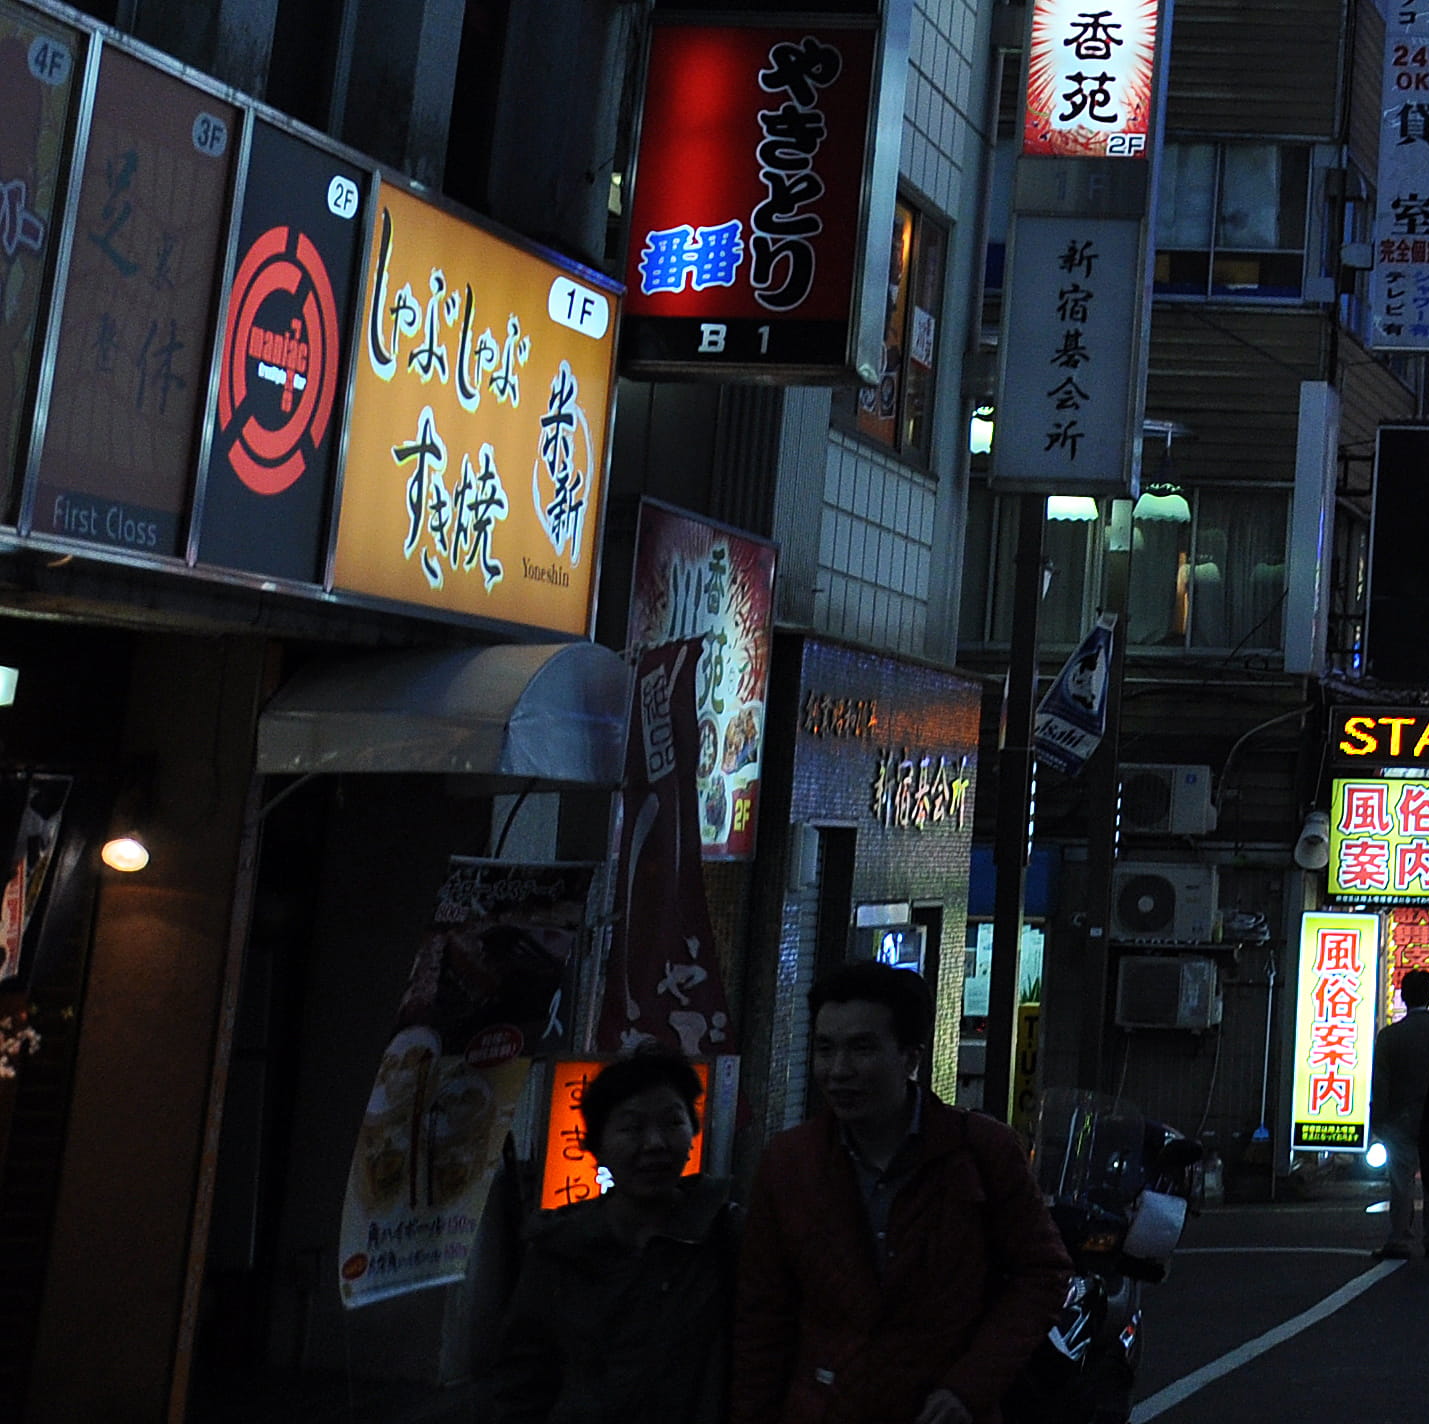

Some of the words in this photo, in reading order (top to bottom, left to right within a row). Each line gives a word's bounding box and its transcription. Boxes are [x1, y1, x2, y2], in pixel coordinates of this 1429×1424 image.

[1107, 134, 1146, 156] 2F
[749, 36, 843, 312] やきとり
[334, 183, 355, 211] 2F
[565, 286, 596, 327] 1F
[697, 322, 771, 355] B1
[521, 557, 571, 588] Yoneshin
[1308, 928, 1365, 1116] 風俗案内
